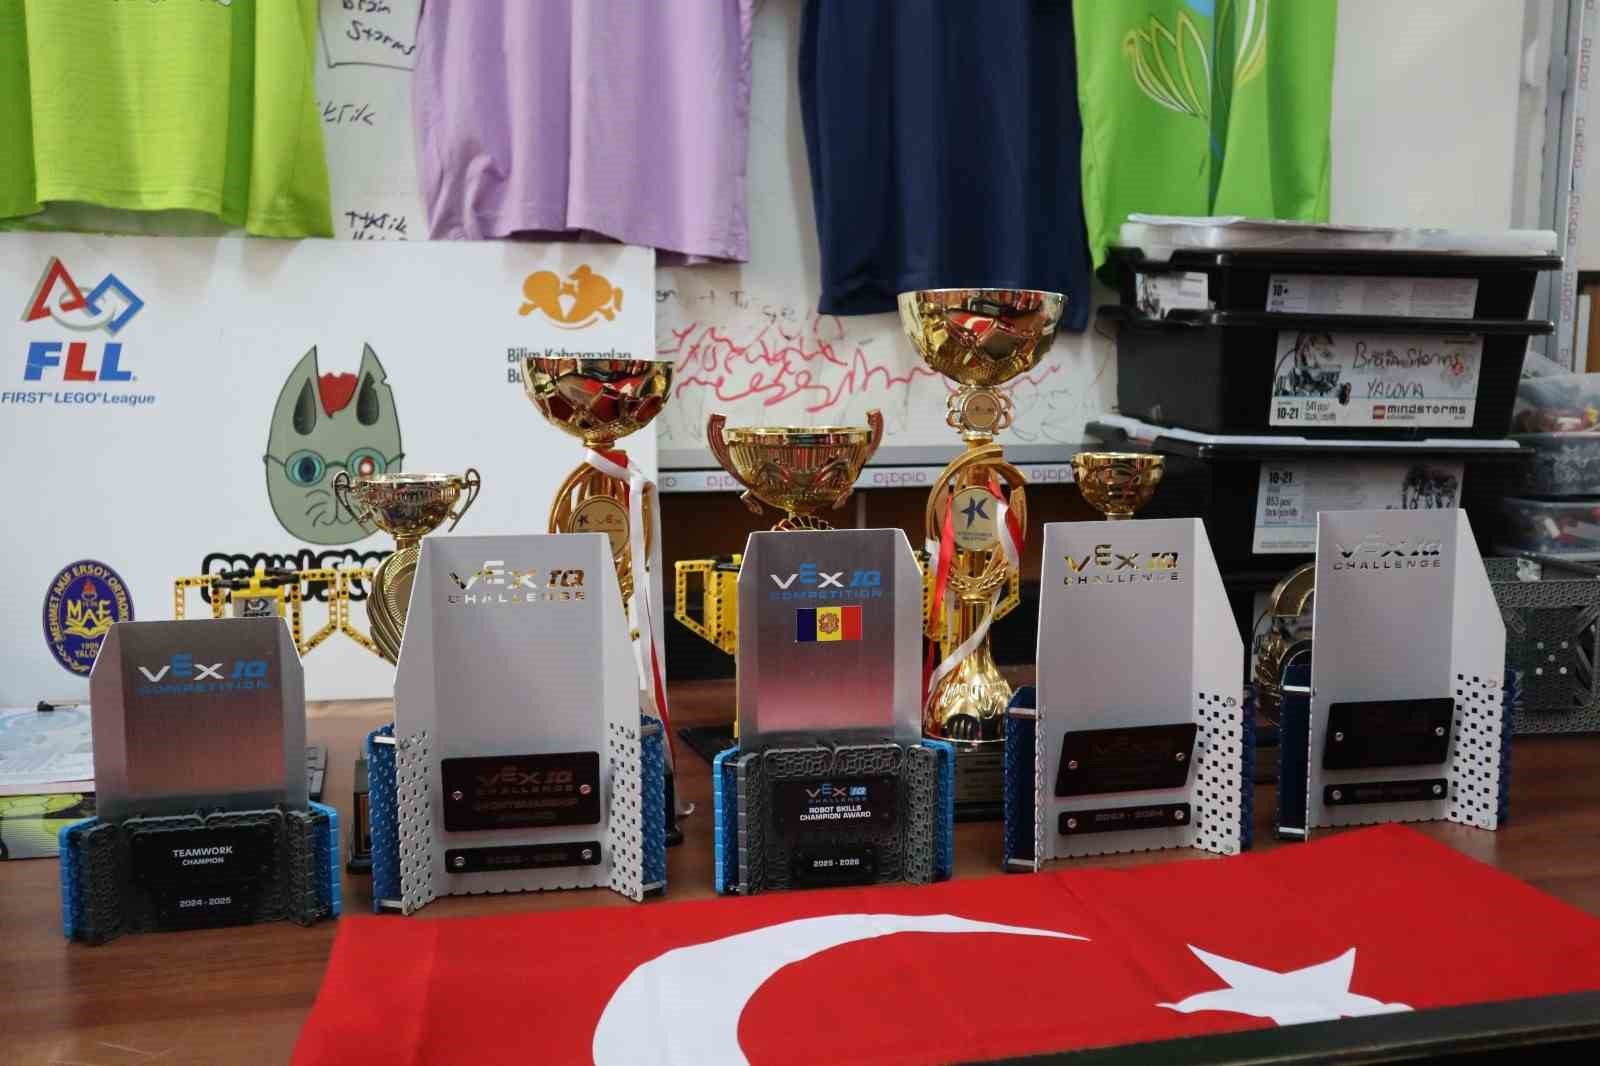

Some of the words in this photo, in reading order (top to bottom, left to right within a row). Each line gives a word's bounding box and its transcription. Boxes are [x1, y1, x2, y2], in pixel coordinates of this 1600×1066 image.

[24, 341, 133, 382] FLL
[1277, 408, 1299, 420] 10-21
[1064, 544, 1139, 571] VEX
[1333, 560, 1440, 570] CHALLENGE
[449, 560, 536, 590] VEX
[769, 562, 844, 589] VEX
[137, 651, 225, 682] VEX
[805, 784, 848, 798] VEX
[809, 806, 834, 814] ROBOT
[836, 804, 862, 813] SKILLS
[800, 812, 841, 821] CHAMPION
[843, 811, 871, 819] AWARD
[172, 845, 233, 858] TEAMWORK
[182, 856, 224, 866] CHAMPION
